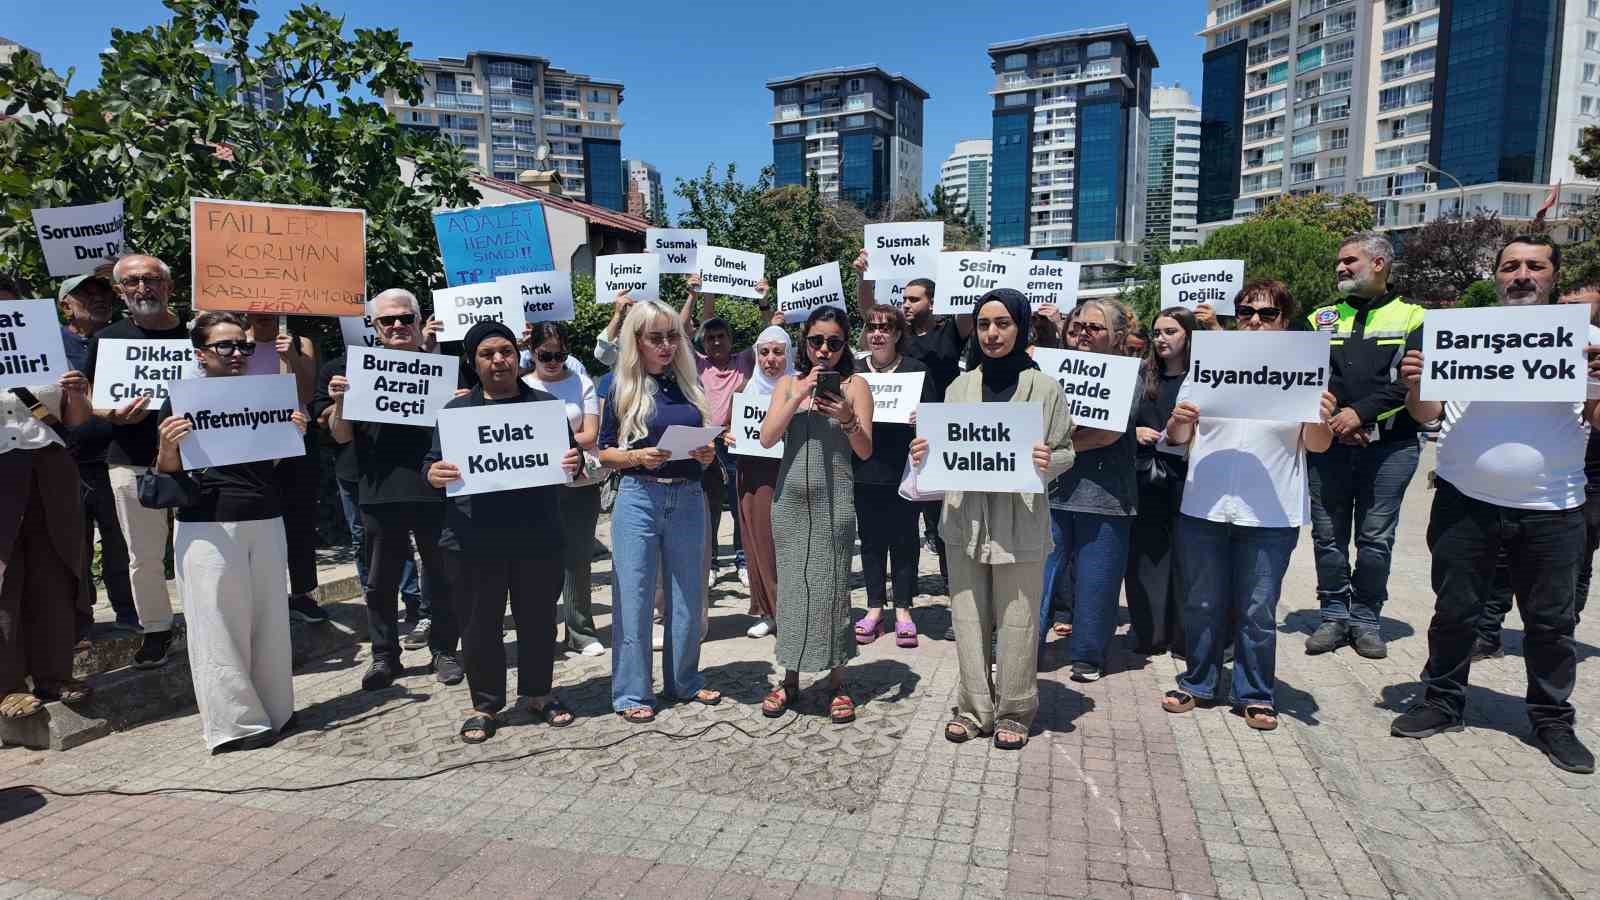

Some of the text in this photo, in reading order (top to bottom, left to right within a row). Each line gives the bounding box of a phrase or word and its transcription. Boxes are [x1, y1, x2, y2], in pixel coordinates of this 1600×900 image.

[448, 208, 532, 232] ADALET
[464, 230, 530, 249] HEMEN
[656, 238, 698, 249] Susmak
[877, 234, 930, 248] Susmak
[74, 245, 103, 260] Dur
[226, 243, 339, 262] KORUYAN
[667, 253, 688, 264] Yok
[890, 253, 915, 266] Yok
[610, 263, 642, 277] İçimiz
[714, 255, 747, 271] Ölmek
[958, 259, 1006, 274] Sesim
[1029, 264, 1063, 276] dalet
[605, 281, 647, 291] Yanıyor
[791, 275, 822, 293] Kabul
[963, 275, 998, 288] Olur
[1027, 280, 1063, 290] emen
[1171, 270, 1233, 285] Güvende
[521, 283, 552, 295] Artık
[1025, 292, 1057, 303] imdi
[1178, 288, 1226, 303] Değiliz
[455, 295, 503, 308] Dayan
[781, 292, 840, 311] Etmiyoruz
[950, 294, 981, 306] mus
[0, 311, 25, 328] at
[0, 332, 17, 351] il
[1436, 326, 1573, 353] Barışacak
[126, 346, 193, 361] Dikkat
[134, 364, 182, 380] Katil
[363, 354, 443, 376] Buradan
[1058, 358, 1107, 378] Alkol
[1431, 358, 1575, 380] Kimse Yok
[1194, 360, 1324, 390] İsyandayız!
[110, 382, 168, 402] Çıkab
[374, 375, 429, 395] Azrail
[375, 396, 425, 417] Geçti
[1067, 400, 1109, 420] liam
[184, 407, 294, 430] Affetmiyoruz
[478, 422, 534, 444] Evlat
[948, 422, 1010, 442] Bıktık
[468, 451, 549, 474] Kokusu
[942, 452, 1016, 471] Vallahi
